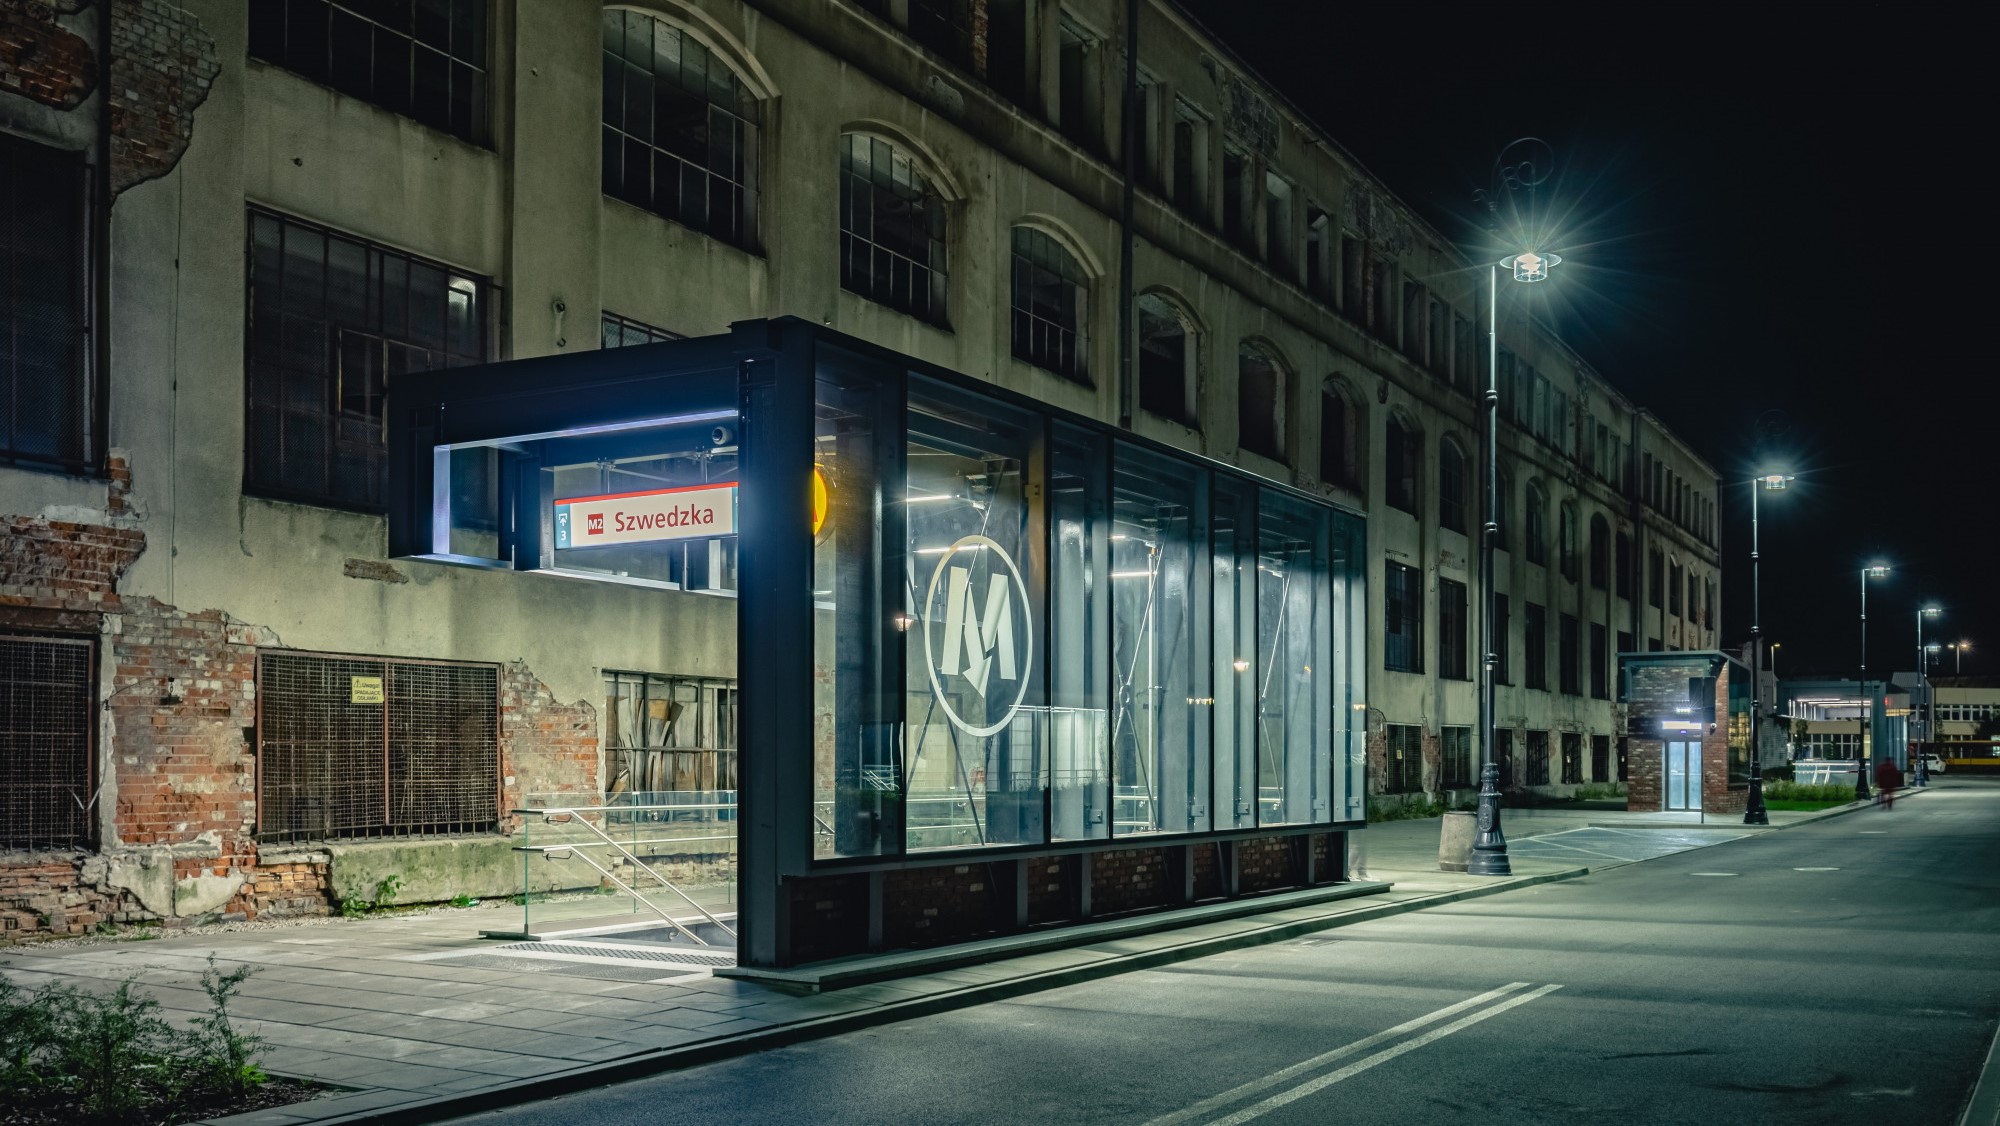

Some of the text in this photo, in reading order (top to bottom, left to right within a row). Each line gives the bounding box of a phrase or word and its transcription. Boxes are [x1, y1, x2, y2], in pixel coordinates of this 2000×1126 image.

[588, 503, 714, 532] M2 Szwedzka
[560, 531, 567, 541] 3
